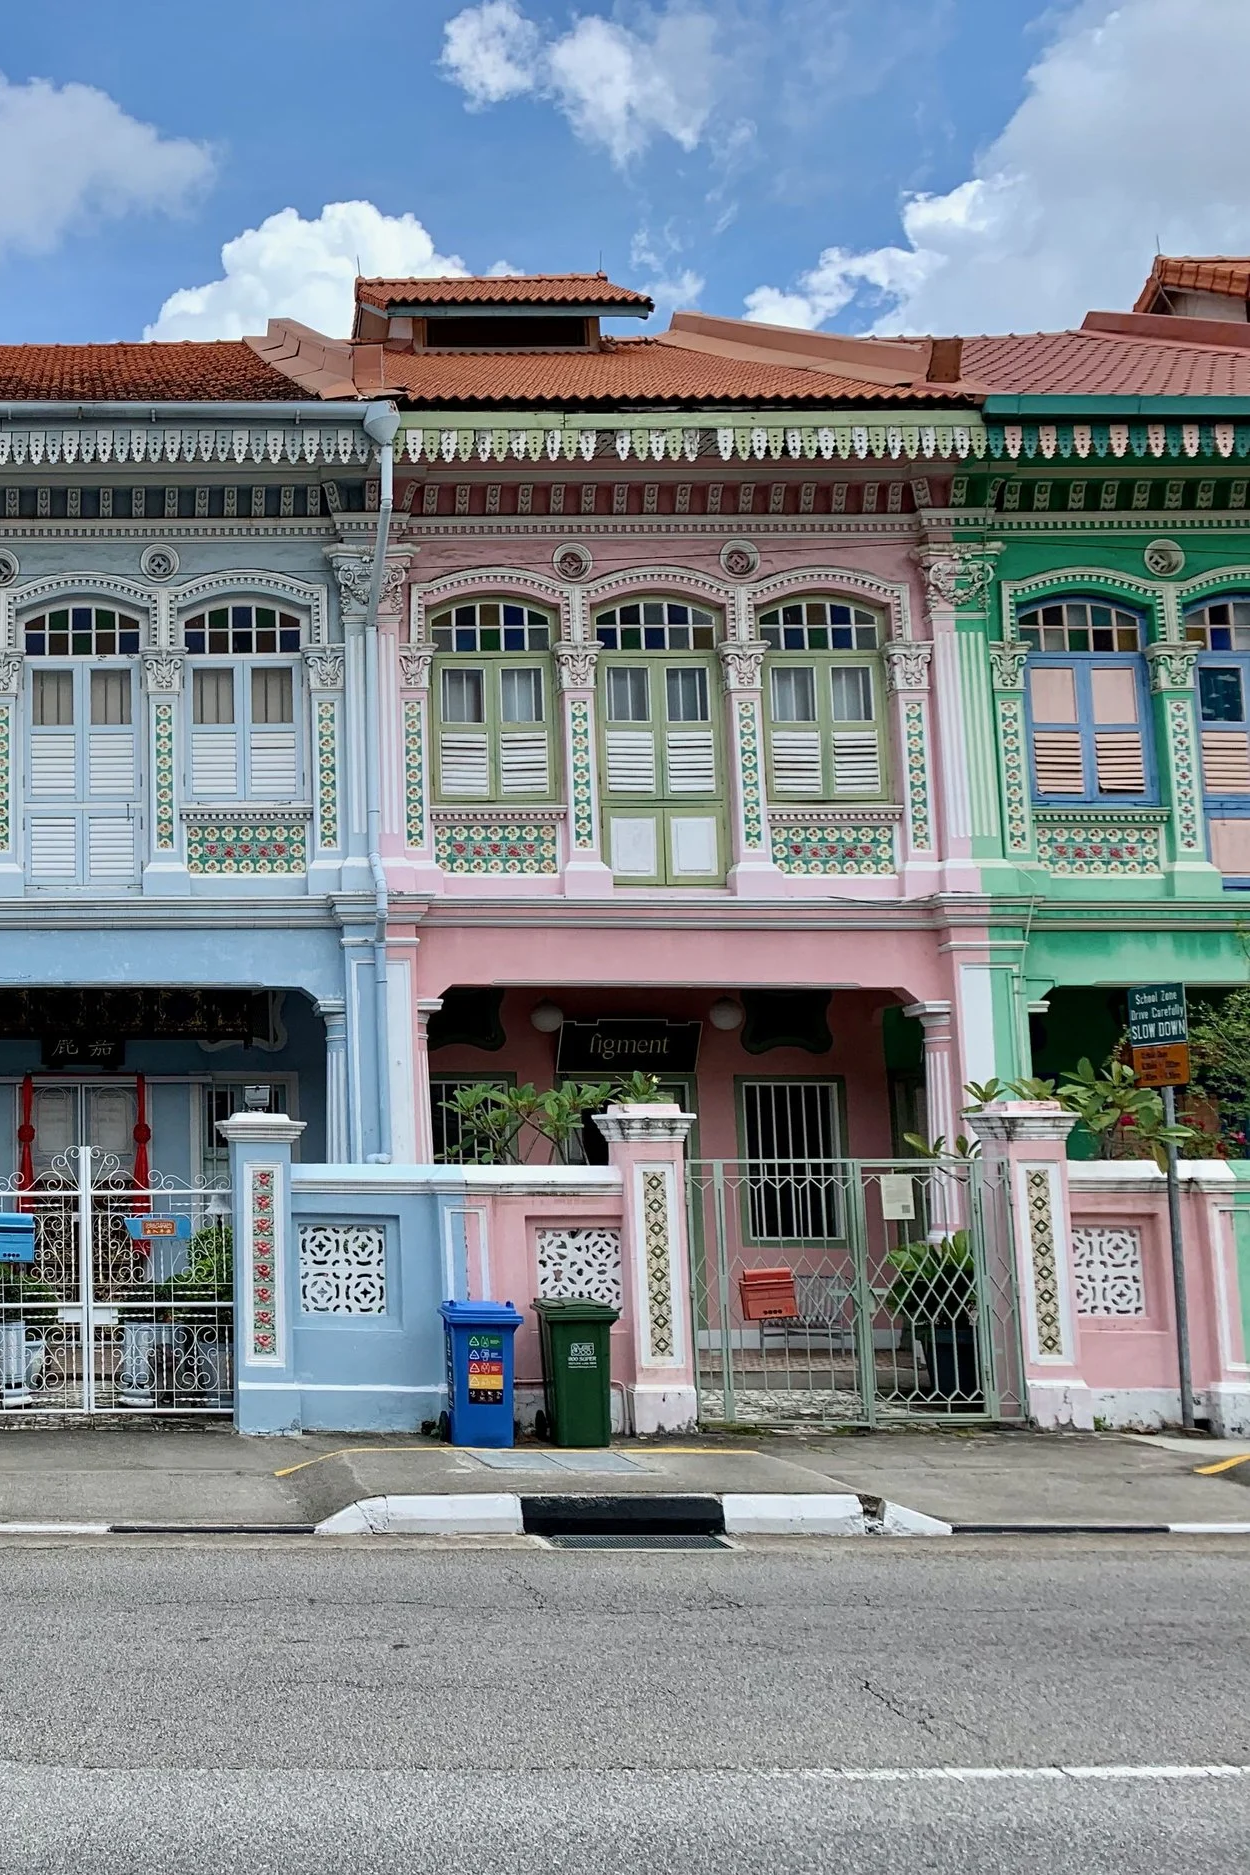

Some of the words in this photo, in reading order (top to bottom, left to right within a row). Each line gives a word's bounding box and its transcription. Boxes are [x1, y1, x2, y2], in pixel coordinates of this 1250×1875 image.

[1135, 991, 1158, 1006] School
[1160, 989, 1178, 1002] Zone
[1131, 1009, 1149, 1021] Drive
[1151, 1003, 1184, 1019] Carefully
[1131, 1022, 1156, 1040] SLOW
[1158, 1019, 1186, 1037] DOWN
[590, 1033, 670, 1060] figment
